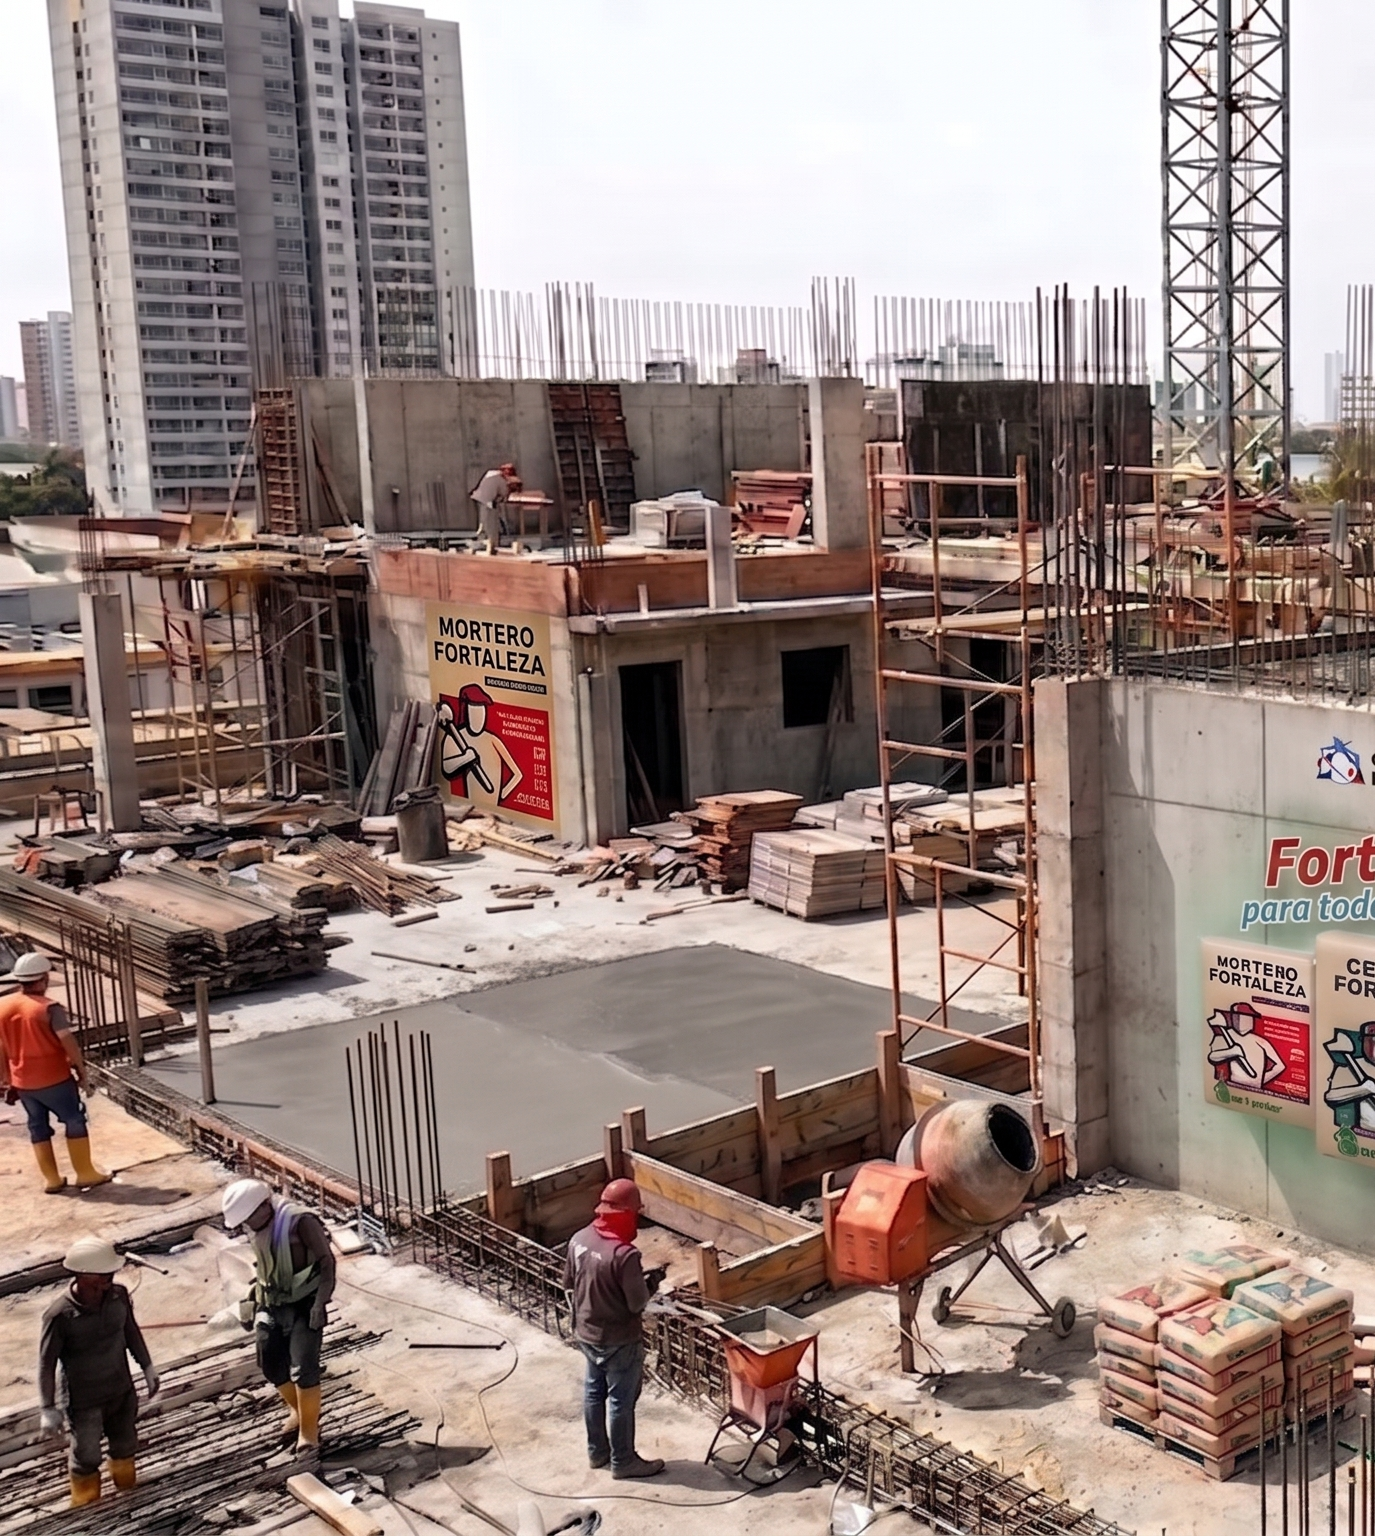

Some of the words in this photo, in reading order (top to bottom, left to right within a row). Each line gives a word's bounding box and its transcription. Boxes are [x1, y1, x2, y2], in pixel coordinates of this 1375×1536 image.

[438, 616, 535, 648] MORTERO
[434, 640, 546, 677] FORTALEZA
[1240, 896, 1312, 931] para
[1209, 967, 1307, 999] FORTALEZA
